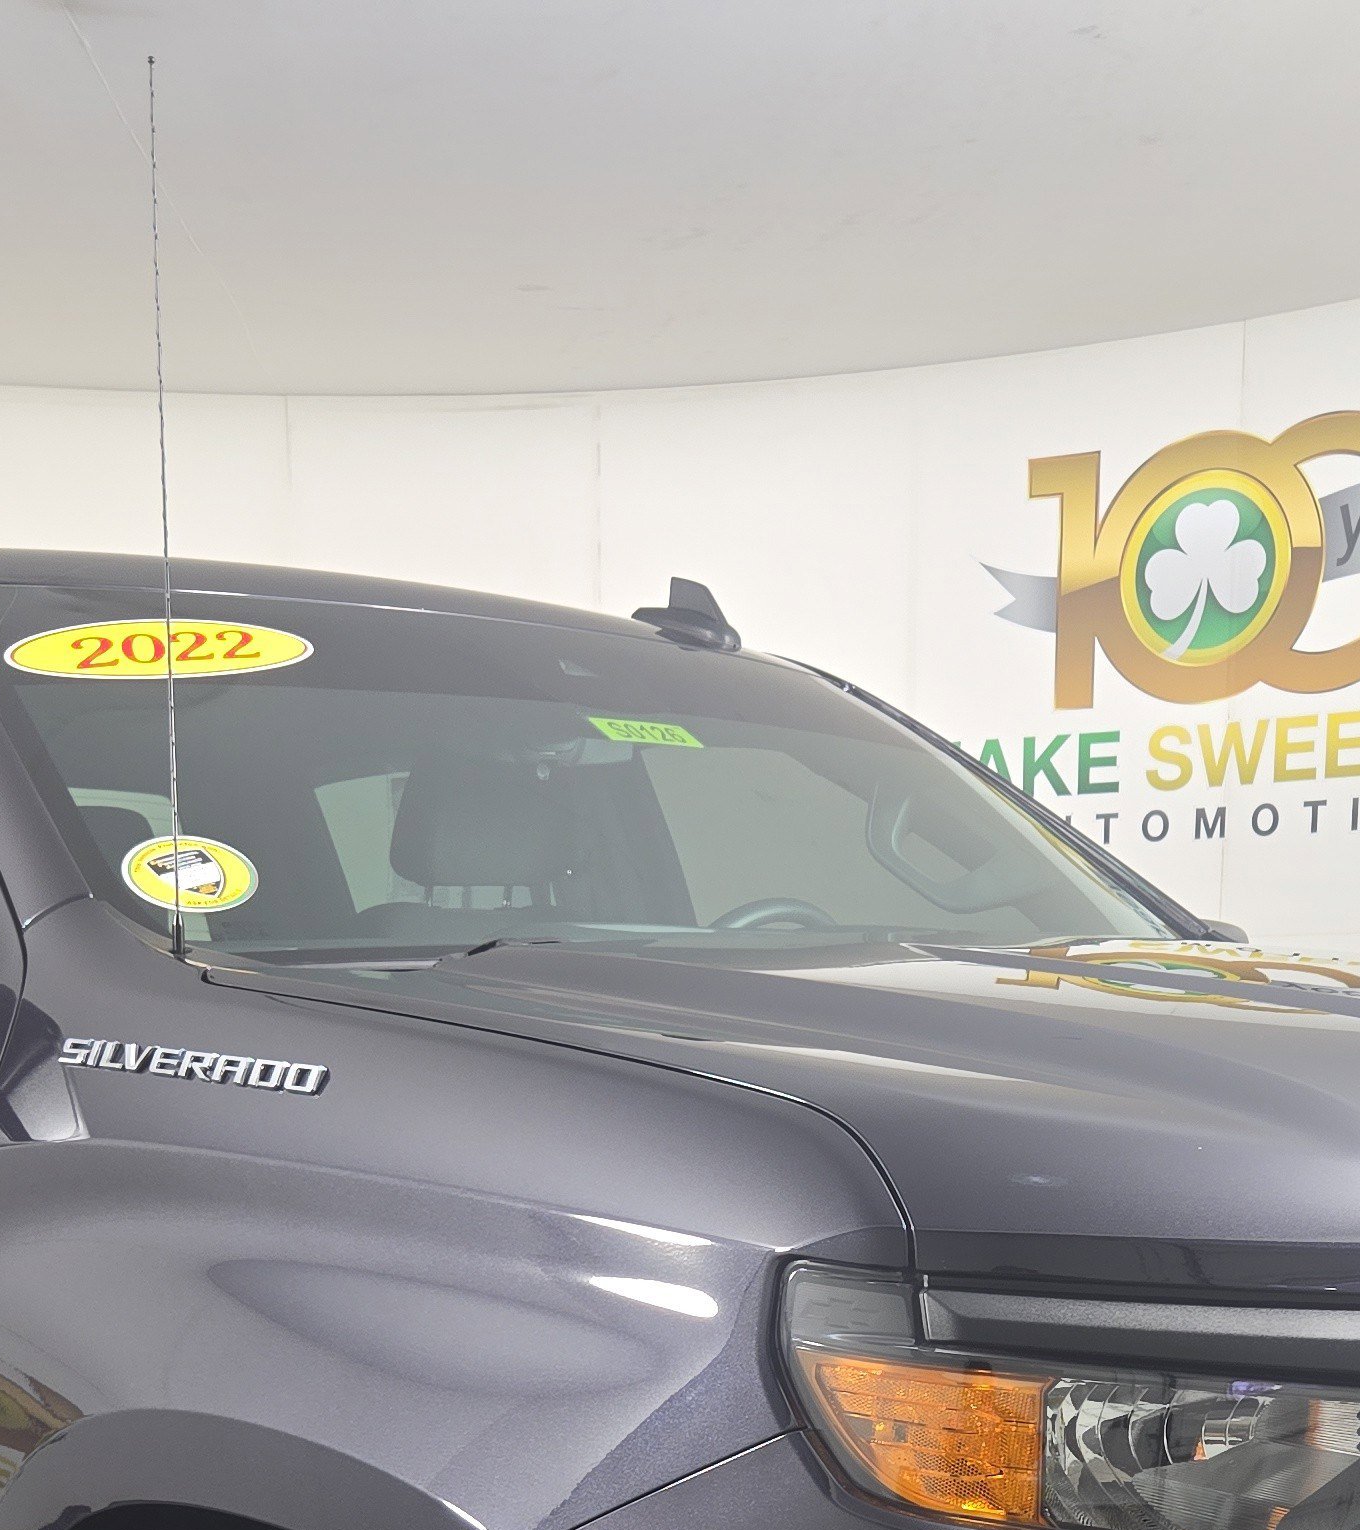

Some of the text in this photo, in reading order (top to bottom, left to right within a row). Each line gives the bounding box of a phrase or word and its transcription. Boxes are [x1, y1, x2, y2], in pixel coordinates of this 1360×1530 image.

[71, 630, 261, 669] 2022
[952, 730, 1121, 798] AKE
[58, 1038, 330, 1097] SILVERADO
